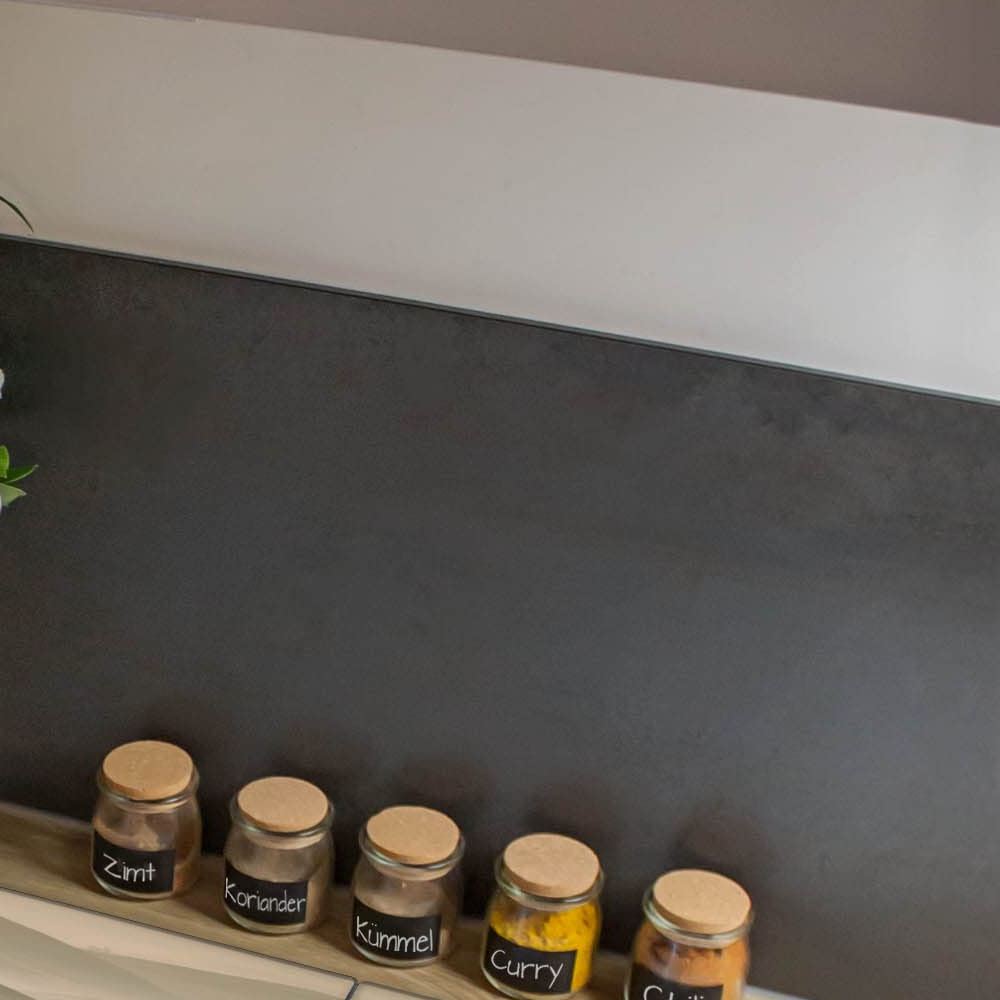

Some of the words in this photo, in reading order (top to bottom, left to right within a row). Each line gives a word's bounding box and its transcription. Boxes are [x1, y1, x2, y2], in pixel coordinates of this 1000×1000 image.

[103, 852, 157, 882] Zimt
[225, 877, 306, 913] Koriander
[356, 915, 434, 953] Kümmel
[490, 949, 564, 990] Curry
